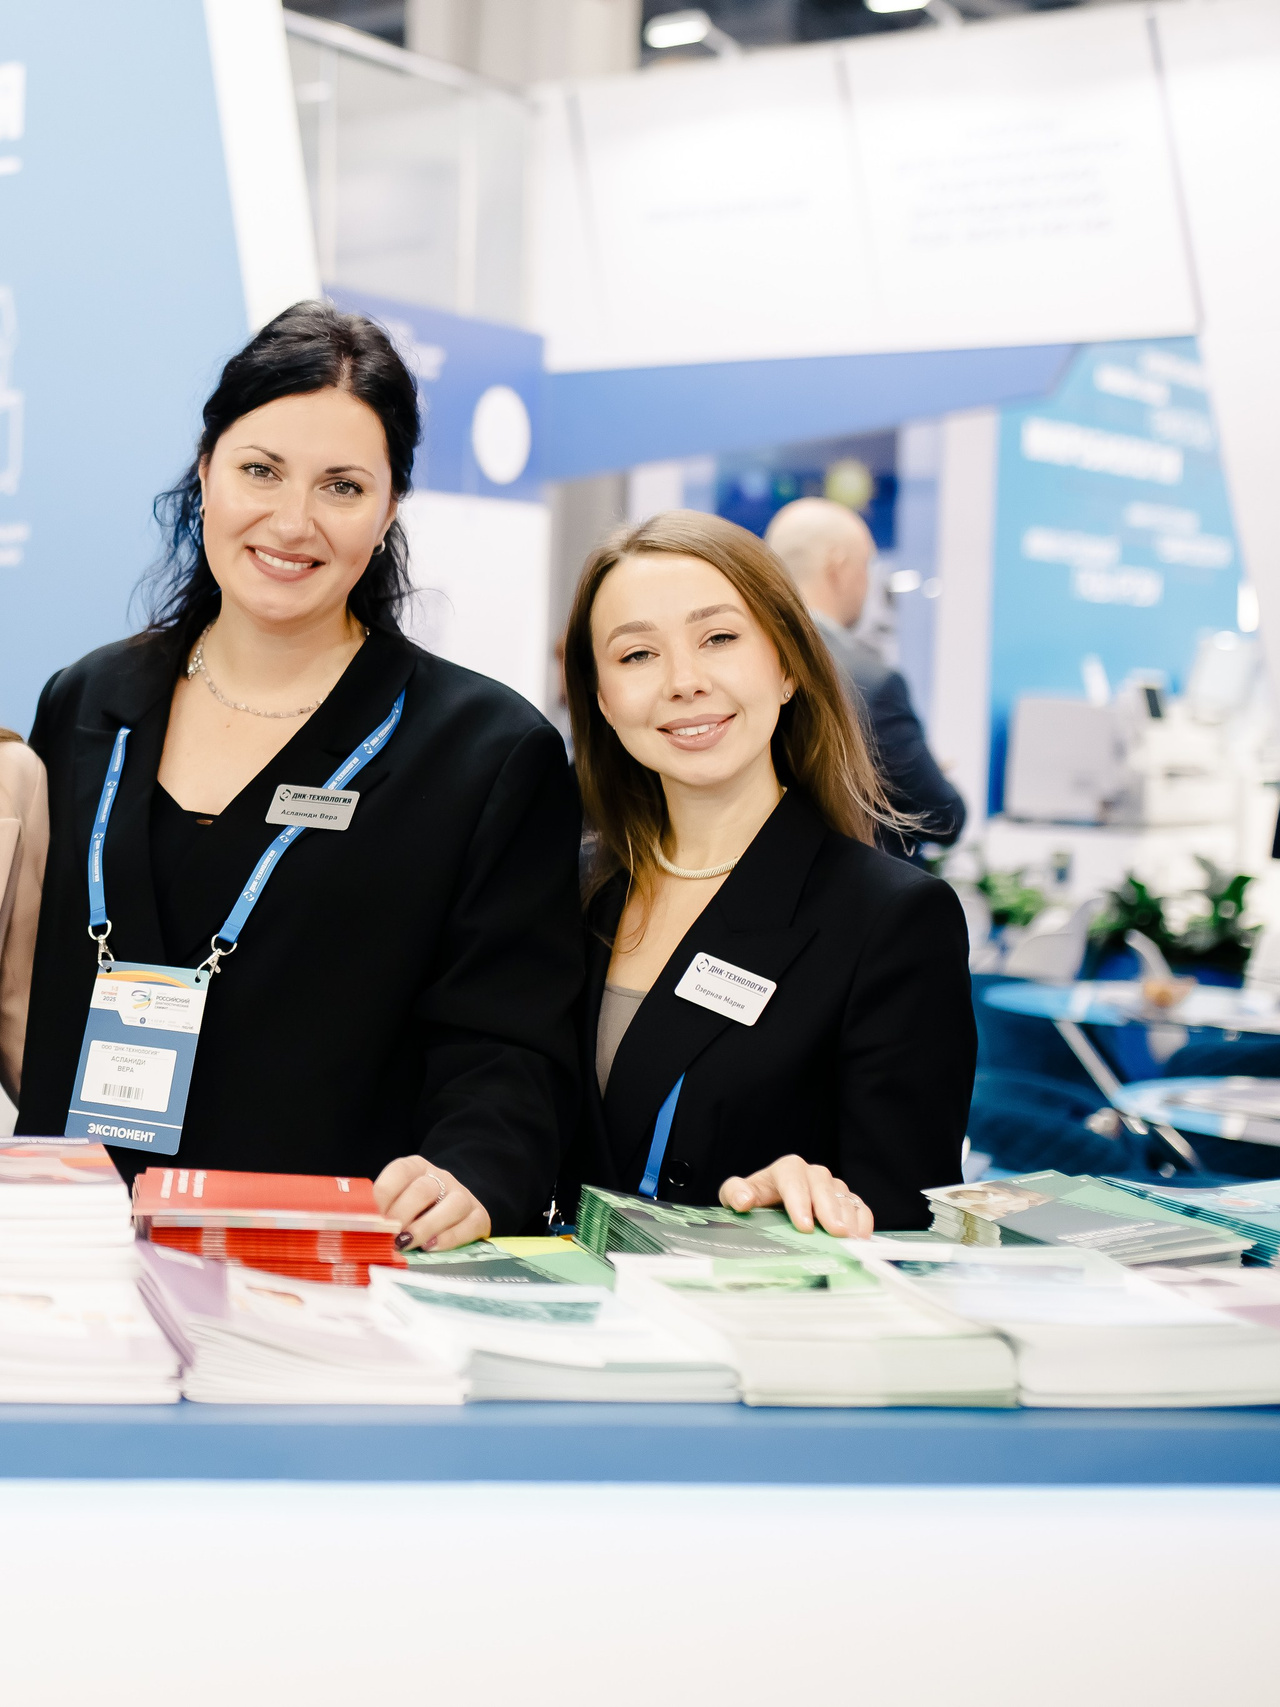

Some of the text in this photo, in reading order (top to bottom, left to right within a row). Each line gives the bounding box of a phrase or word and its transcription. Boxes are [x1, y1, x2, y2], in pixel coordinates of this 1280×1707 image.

[281, 809, 338, 821] Асланиди Вера
[723, 996, 746, 1010] Мария
[111, 1056, 146, 1065] АСЛАНИДИ
[87, 1123, 156, 1143] ЭКСПОНЕНТ
